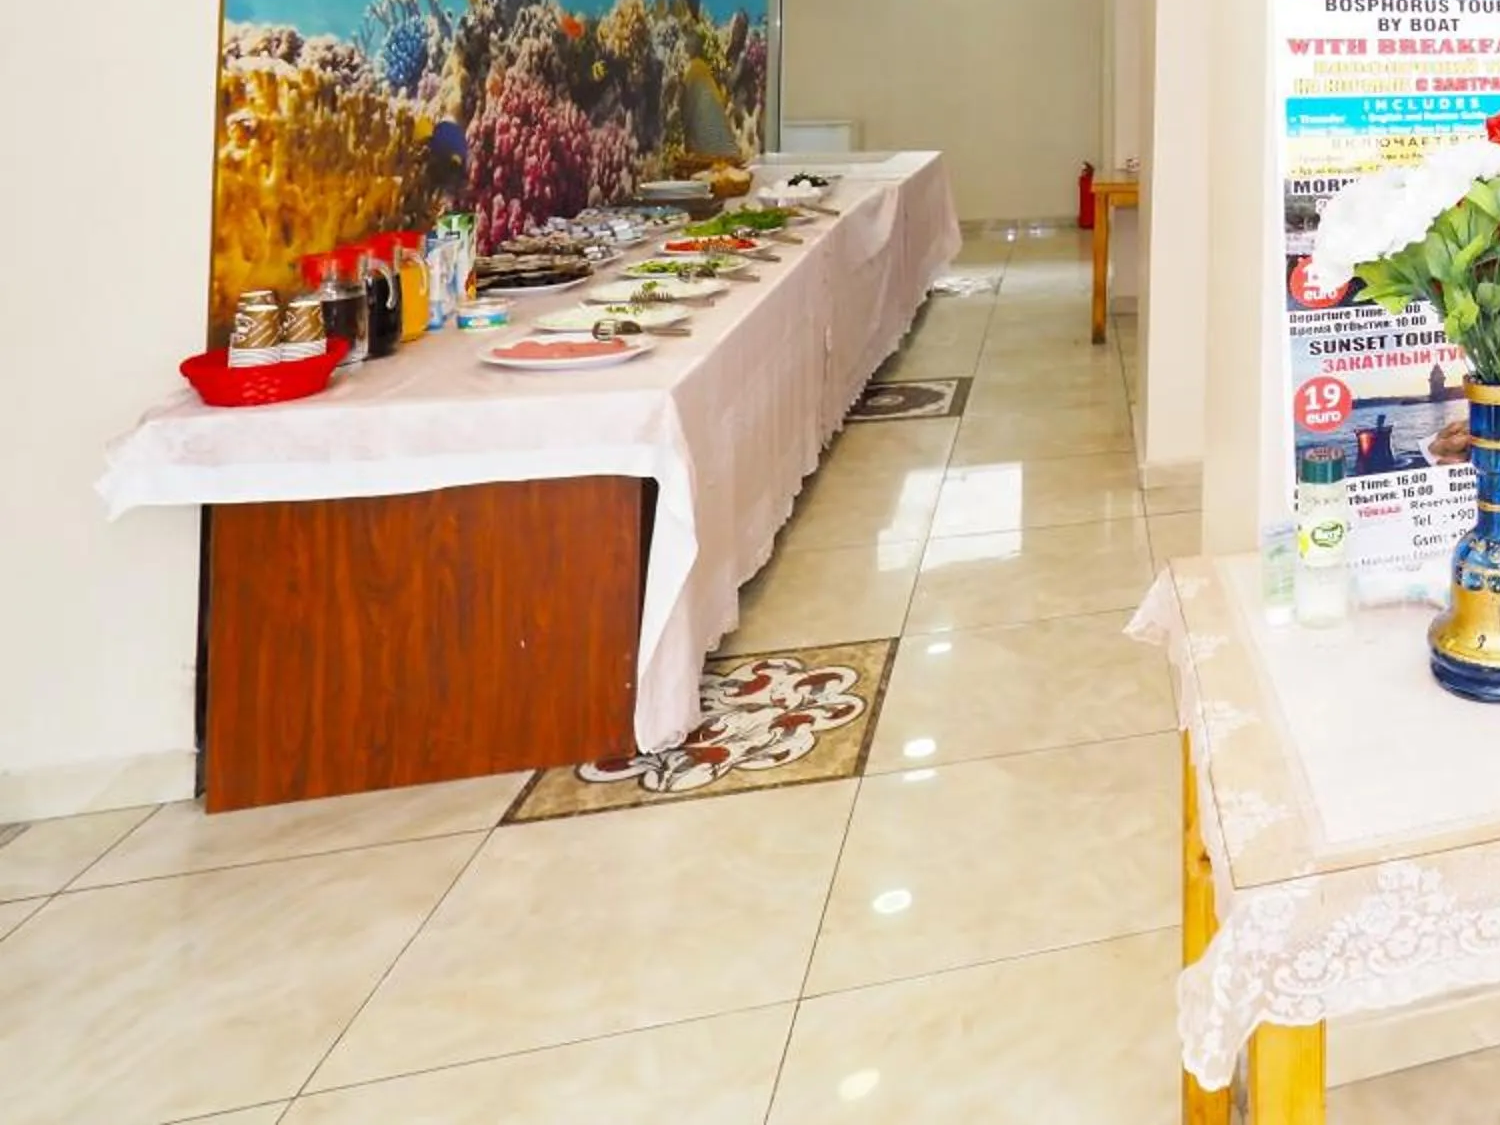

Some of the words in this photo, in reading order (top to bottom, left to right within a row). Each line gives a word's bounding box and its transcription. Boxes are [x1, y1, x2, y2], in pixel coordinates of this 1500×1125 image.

[1377, 17, 1402, 32] BY
[1410, 17, 1460, 32] BOAT
[1287, 38, 1367, 55] WITH
[1363, 97, 1481, 113] INCLUDES
[1290, 310, 1351, 324] Departure
[1309, 334, 1388, 356] SUNSET
[1393, 330, 1446, 348] TOUR
[1304, 383, 1342, 411] 19
[1305, 409, 1342, 424] euro
[1412, 514, 1431, 527] Tel
